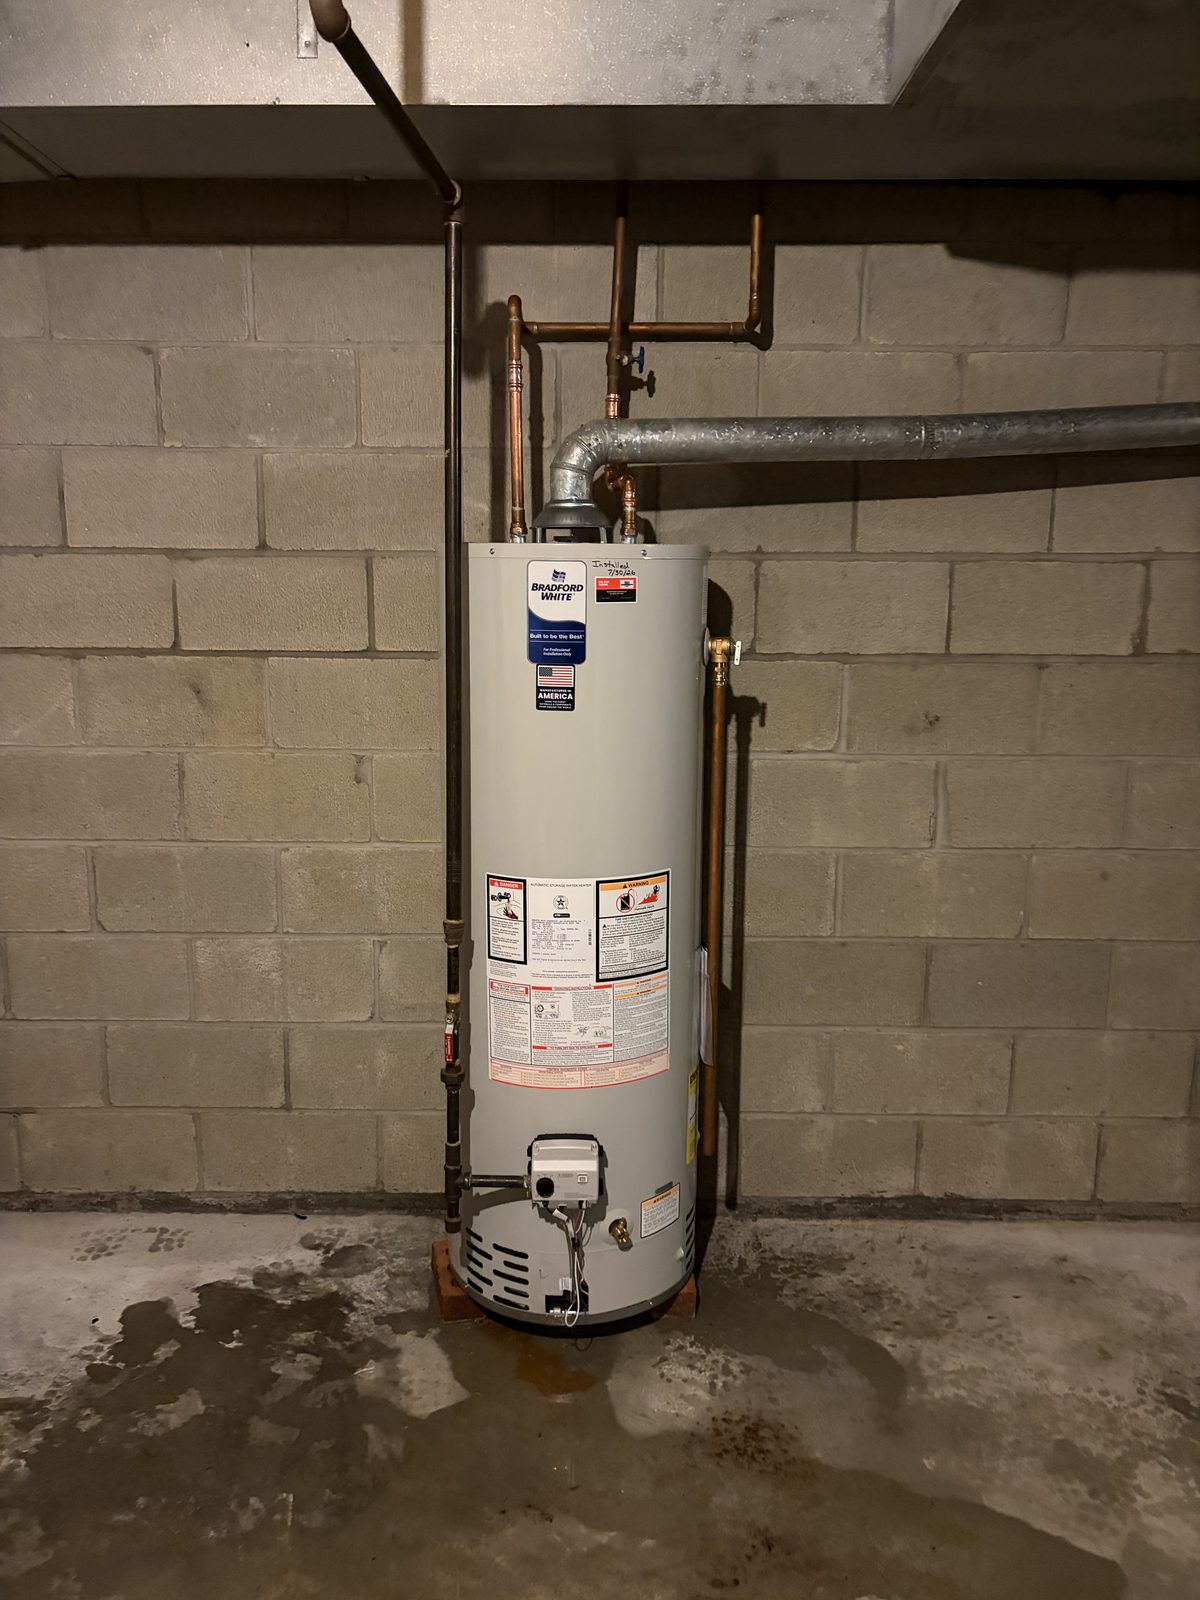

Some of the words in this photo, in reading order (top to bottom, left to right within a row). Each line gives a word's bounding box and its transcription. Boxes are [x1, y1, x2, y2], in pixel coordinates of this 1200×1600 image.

[591, 560, 630, 570] Installed
[531, 582, 584, 592] BRADFORD
[541, 592, 572, 601] WHITE
[538, 692, 573, 700] AMERICA
[500, 881, 519, 889] DANGER
[628, 880, 649, 888] WARNING
